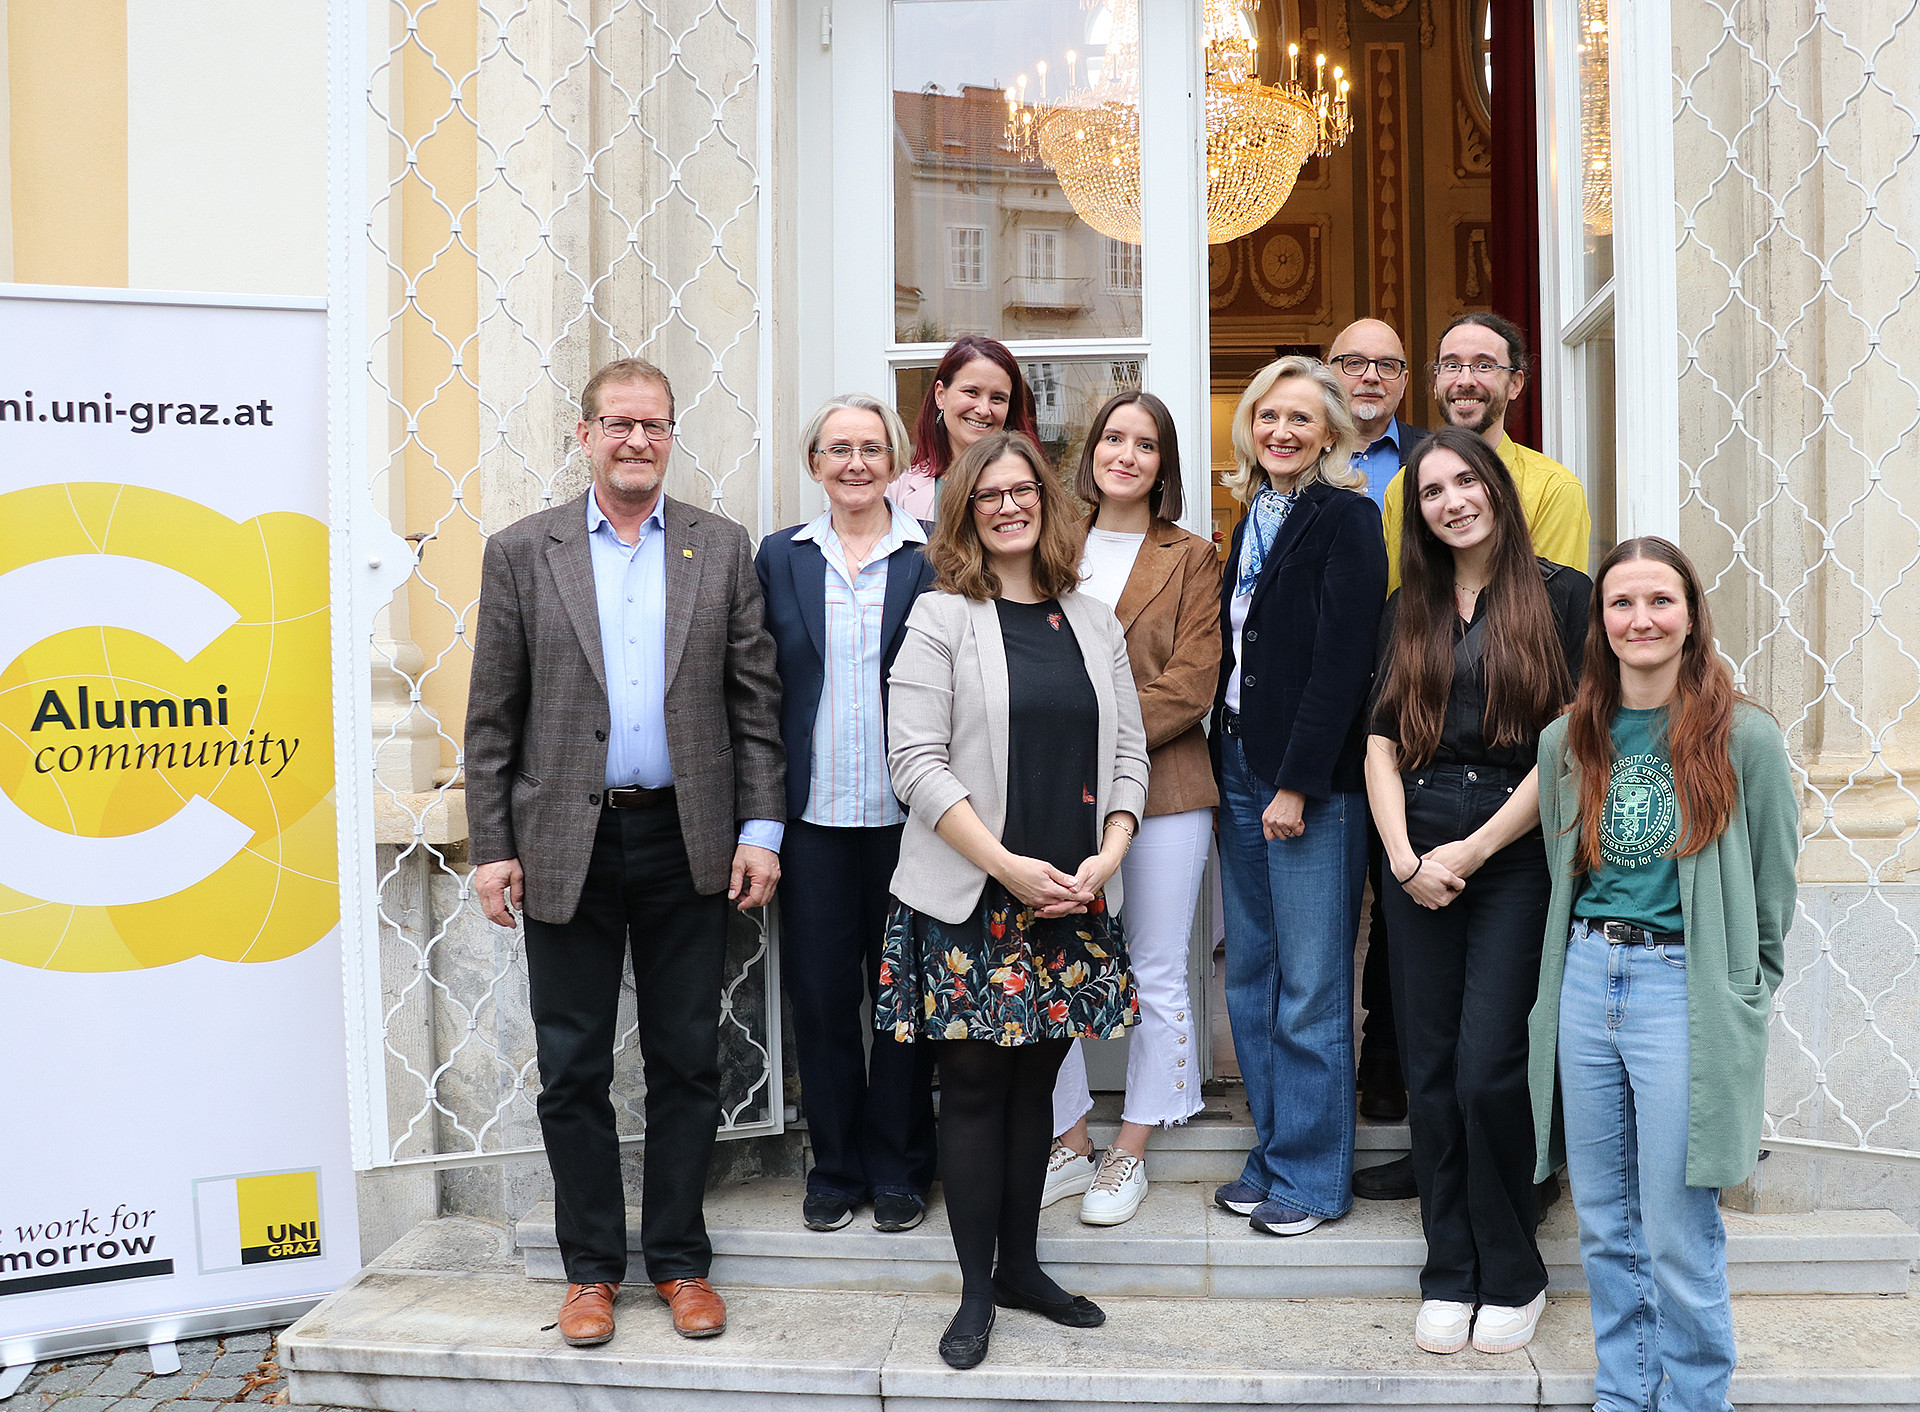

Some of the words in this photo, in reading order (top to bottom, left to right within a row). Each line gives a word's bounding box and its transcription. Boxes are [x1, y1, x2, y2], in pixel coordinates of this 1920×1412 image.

[31, 684, 228, 732] Alumni
[34, 729, 300, 779] community
[1645, 754, 1660, 765] OF
[1661, 762, 1674, 780] GR
[1600, 847, 1635, 868] Working
[1638, 854, 1652, 866] for
[15, 1208, 101, 1243] work
[105, 1203, 156, 1237] for
[267, 1220, 317, 1243] UNI
[268, 1240, 319, 1258] GRAZ
